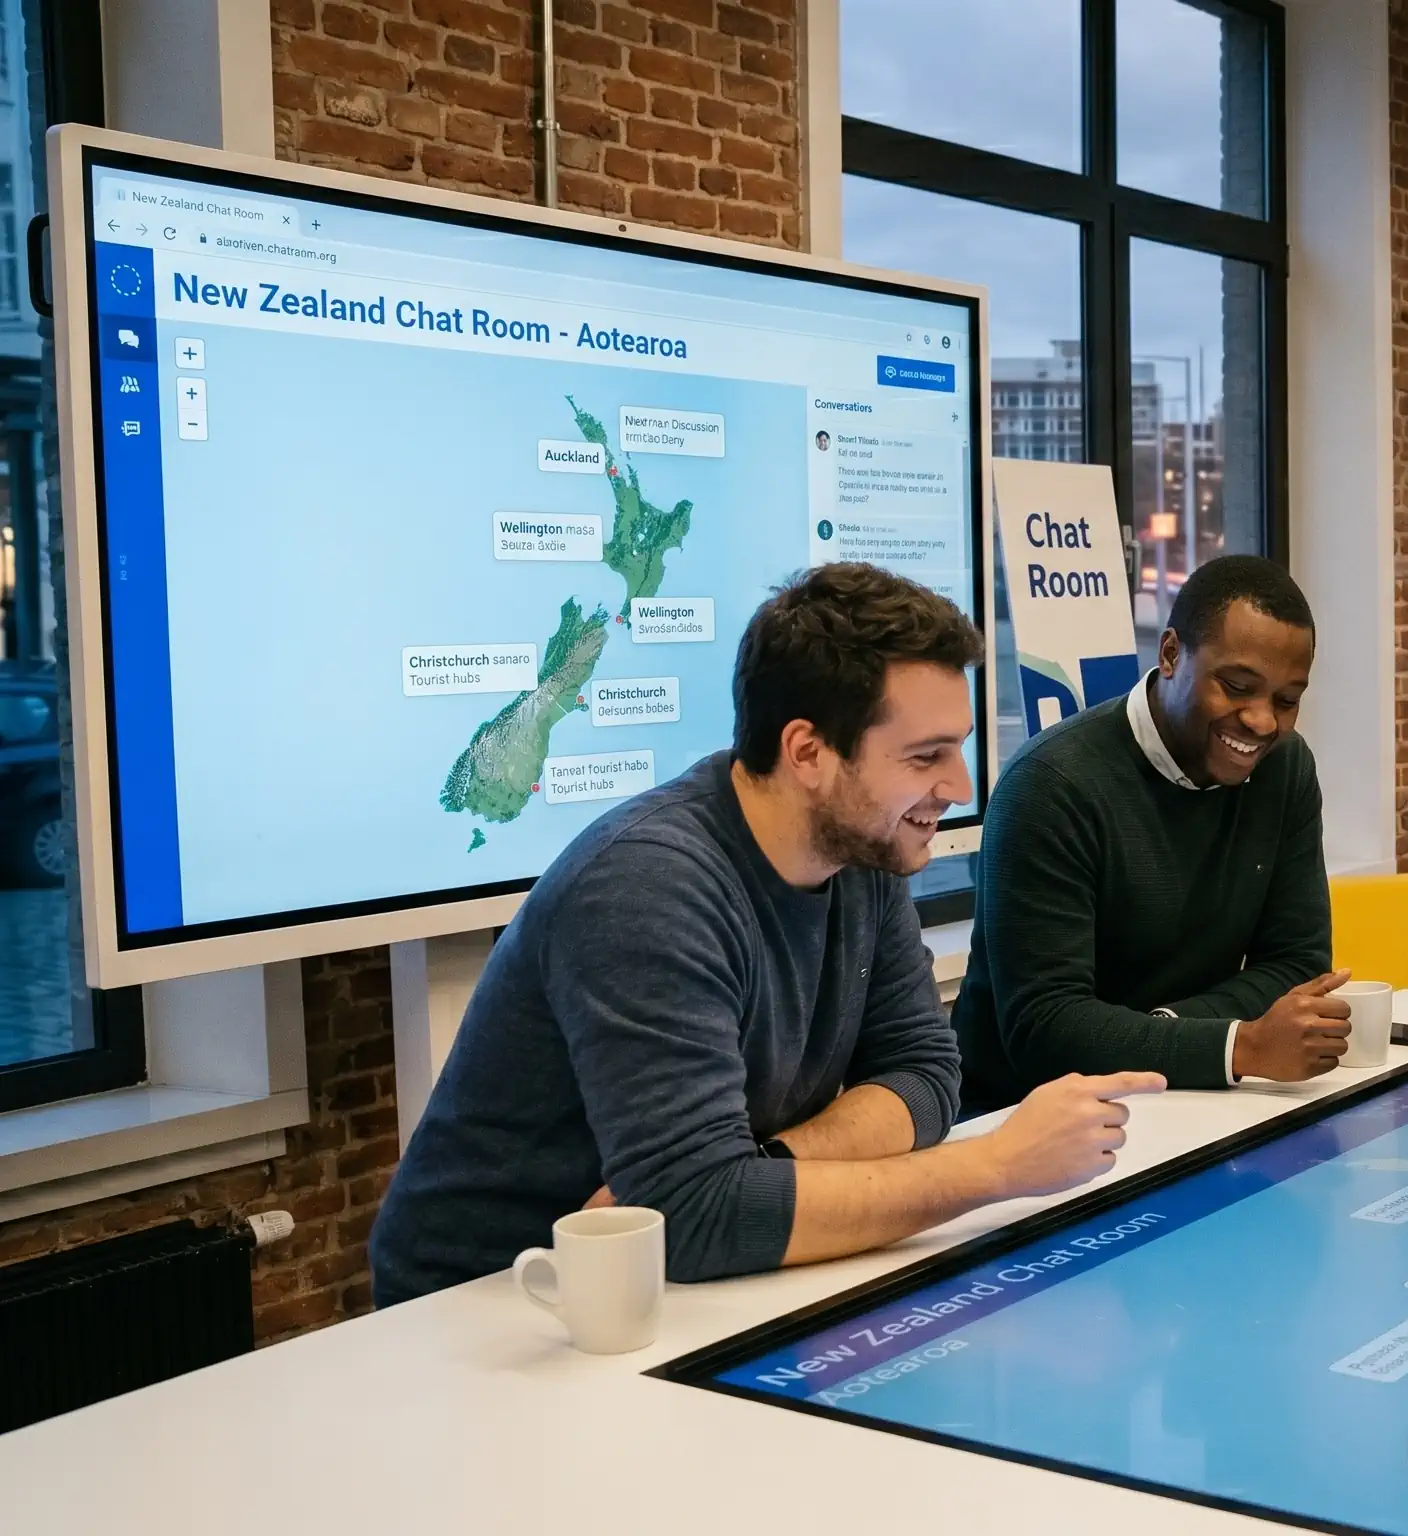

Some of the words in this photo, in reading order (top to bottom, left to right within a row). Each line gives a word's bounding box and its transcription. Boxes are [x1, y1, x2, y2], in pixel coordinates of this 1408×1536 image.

[132, 191, 157, 204] New
[160, 195, 204, 212] Zealand
[206, 203, 231, 216] Chat
[234, 207, 264, 221] Room
[173, 272, 248, 309] New
[259, 282, 385, 325] Zealand
[395, 300, 464, 334] Chat
[471, 308, 551, 344] Room
[576, 322, 688, 359] Aotearoa
[672, 419, 719, 434] Discussion
[544, 449, 600, 465] Auckland
[500, 521, 563, 537] Wellington
[1026, 511, 1092, 549] Chat
[1027, 563, 1109, 598] Room
[638, 606, 694, 620] Wellington
[409, 654, 490, 668] Christchurch
[492, 655, 530, 665] sanaro
[409, 673, 450, 686] Tourist
[453, 672, 481, 684] hubs
[598, 685, 666, 700] Christchurch
[590, 778, 614, 790] hubs
[755, 1344, 857, 1388] New
[849, 1279, 1003, 1347] Zealand
[997, 1247, 1084, 1285] Chat
[1071, 1212, 1166, 1251] Room
[819, 1339, 970, 1407] Aotearoa
